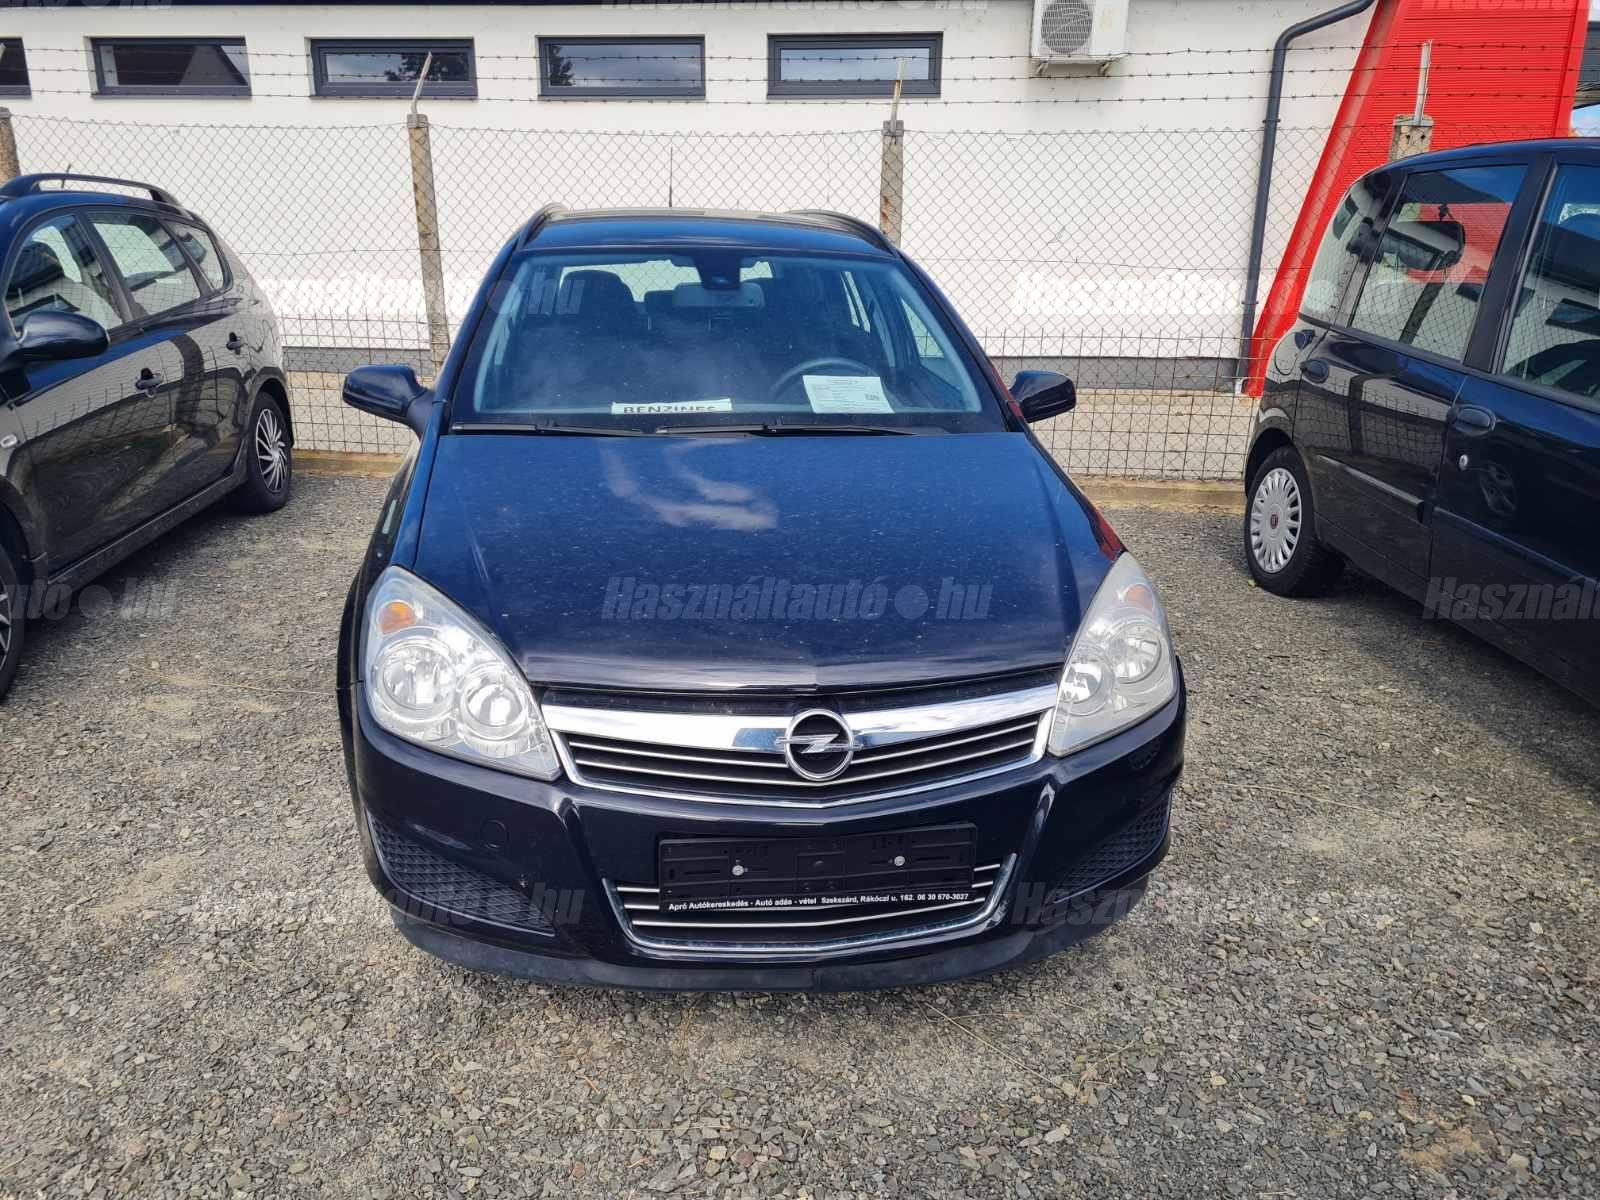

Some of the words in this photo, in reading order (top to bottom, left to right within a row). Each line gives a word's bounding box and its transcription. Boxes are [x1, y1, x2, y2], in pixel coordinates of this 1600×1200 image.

[669, 902, 687, 912] Apró
[755, 897, 773, 906] Autó
[798, 896, 817, 905] vétel
